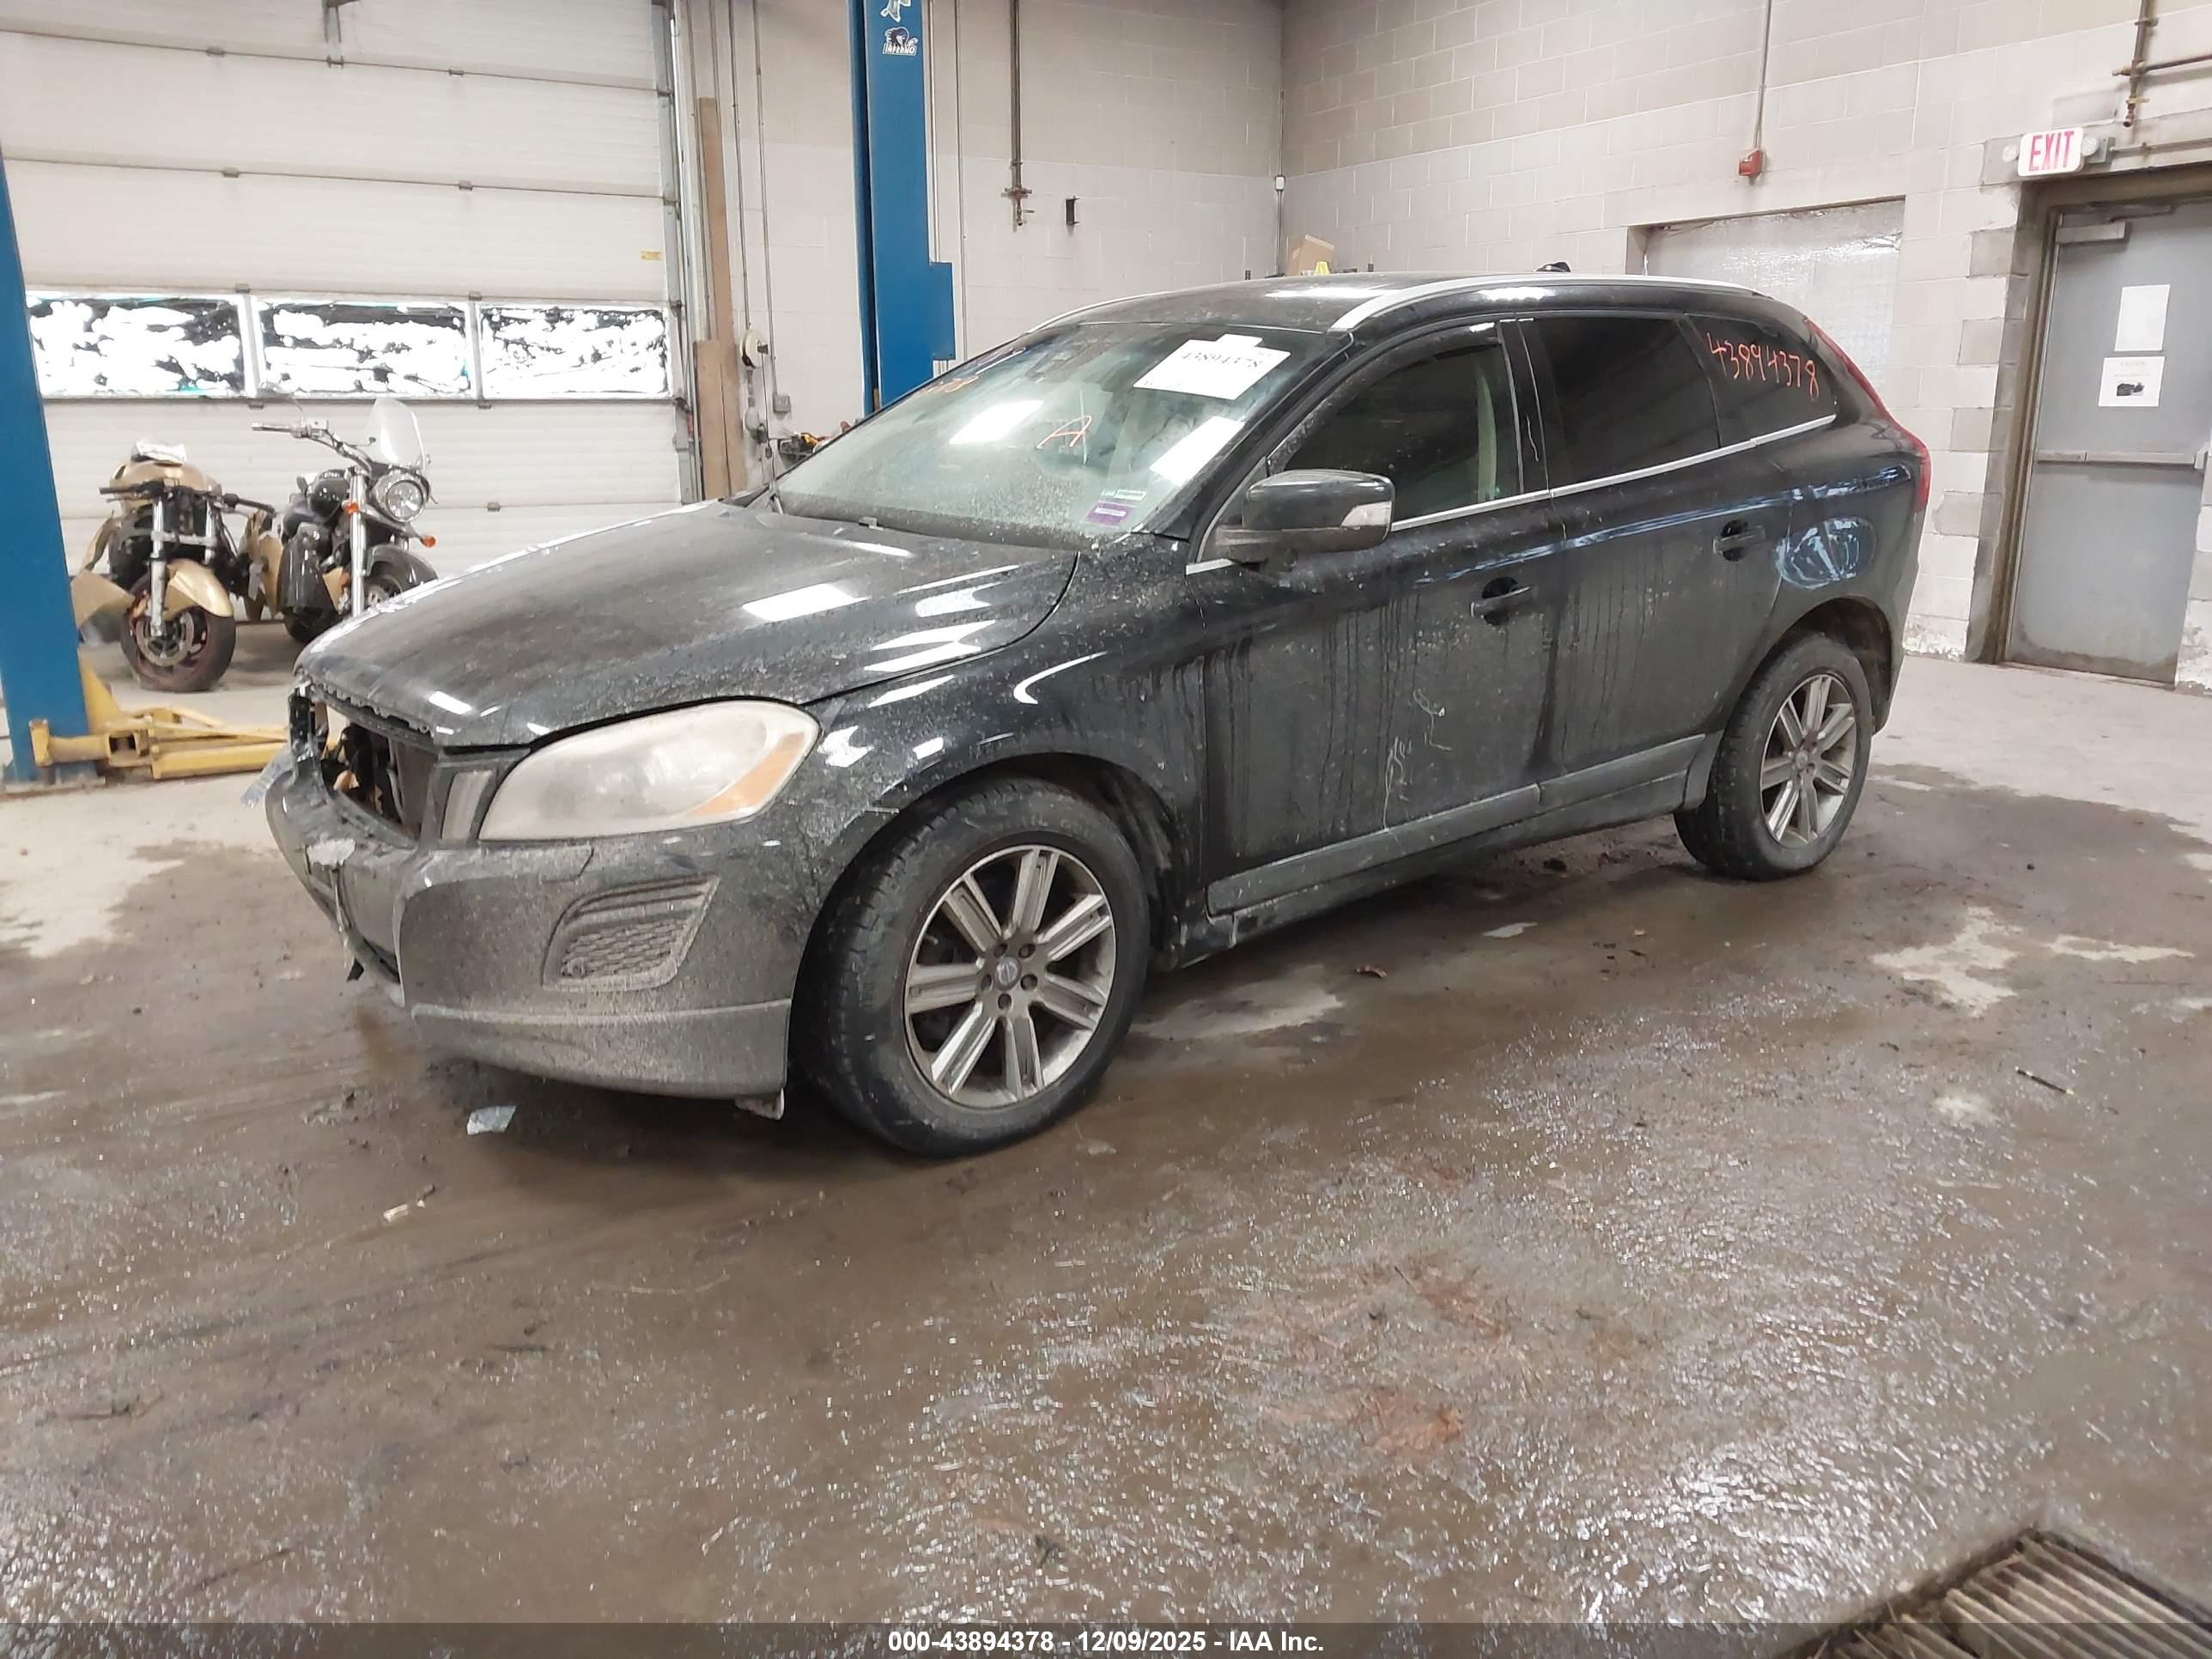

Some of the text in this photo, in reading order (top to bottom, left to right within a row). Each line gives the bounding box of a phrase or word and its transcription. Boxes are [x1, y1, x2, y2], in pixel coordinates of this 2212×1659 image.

[884, 43, 916, 55] INFERNO
[2028, 131, 2075, 172] EXIT
[1706, 331, 1820, 401] 43894378
